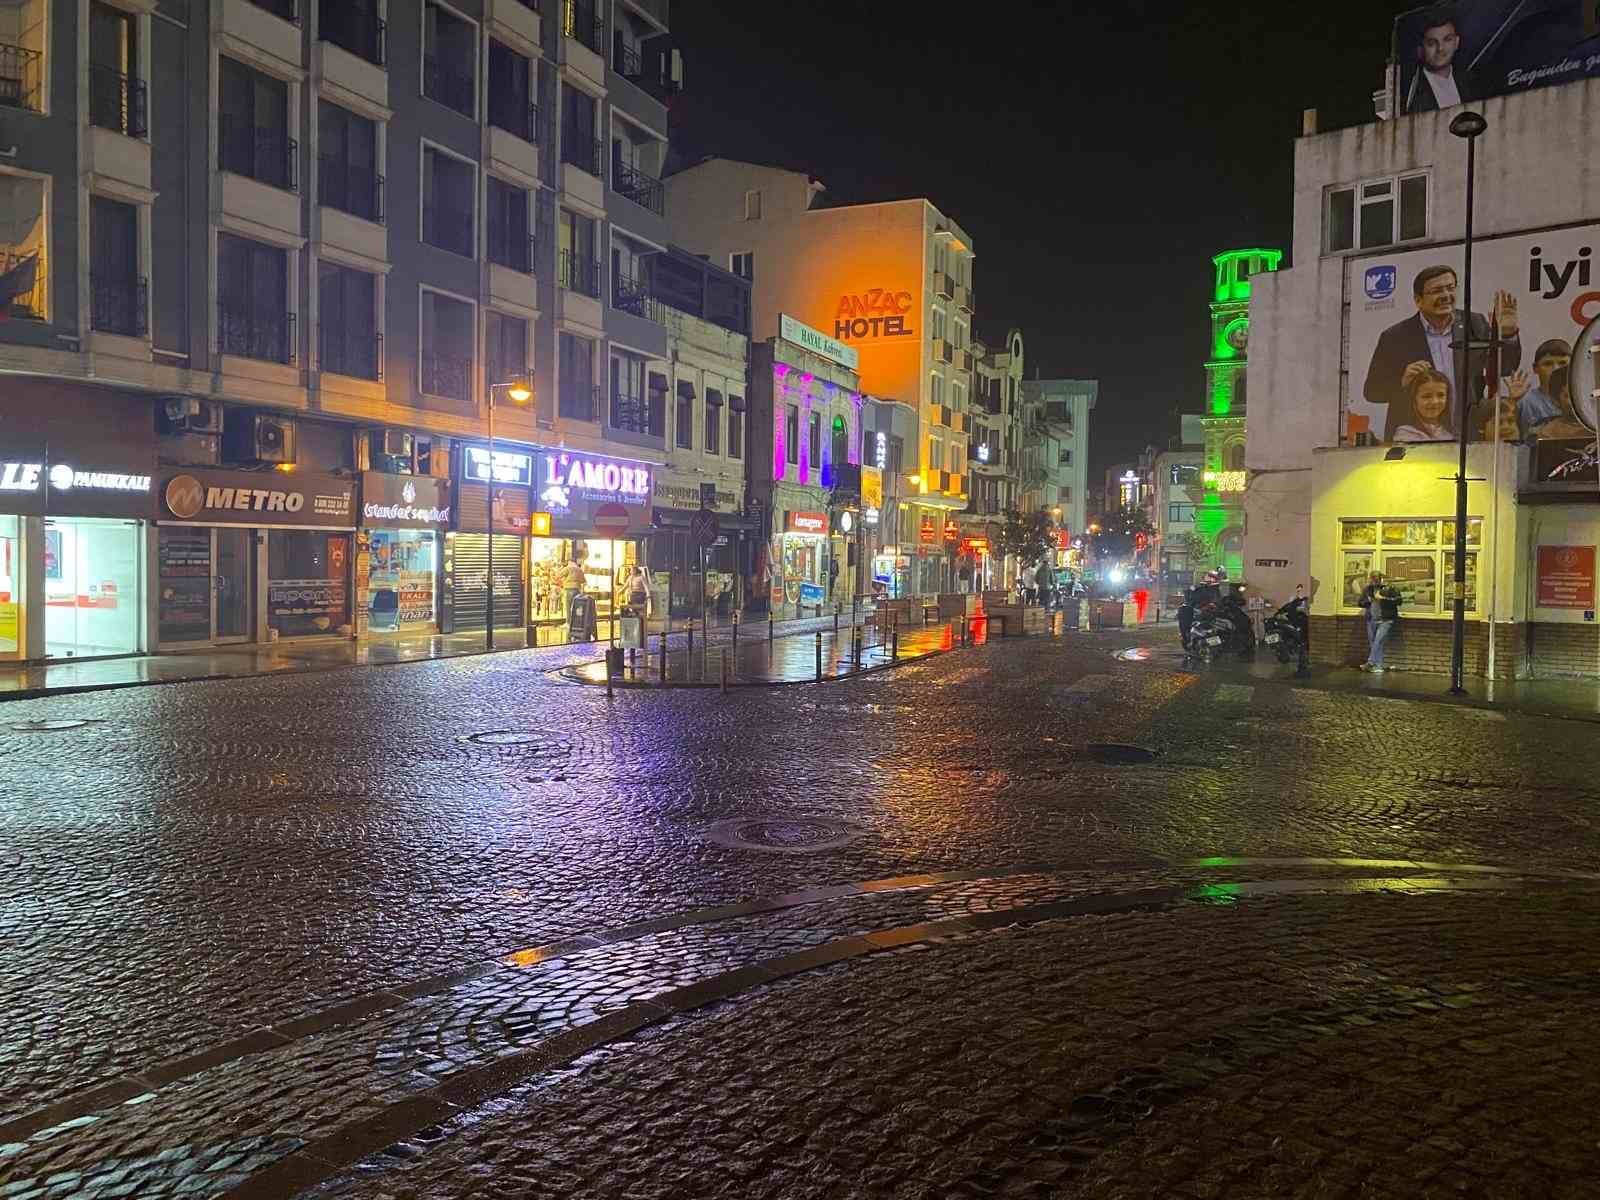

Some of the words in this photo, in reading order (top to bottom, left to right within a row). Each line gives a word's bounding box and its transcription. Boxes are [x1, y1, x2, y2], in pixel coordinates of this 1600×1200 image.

[836, 288, 912, 317] ANZAC
[835, 316, 912, 339] HOTEL
[546, 455, 649, 494] L'AMORE
[205, 487, 304, 513] METRO
